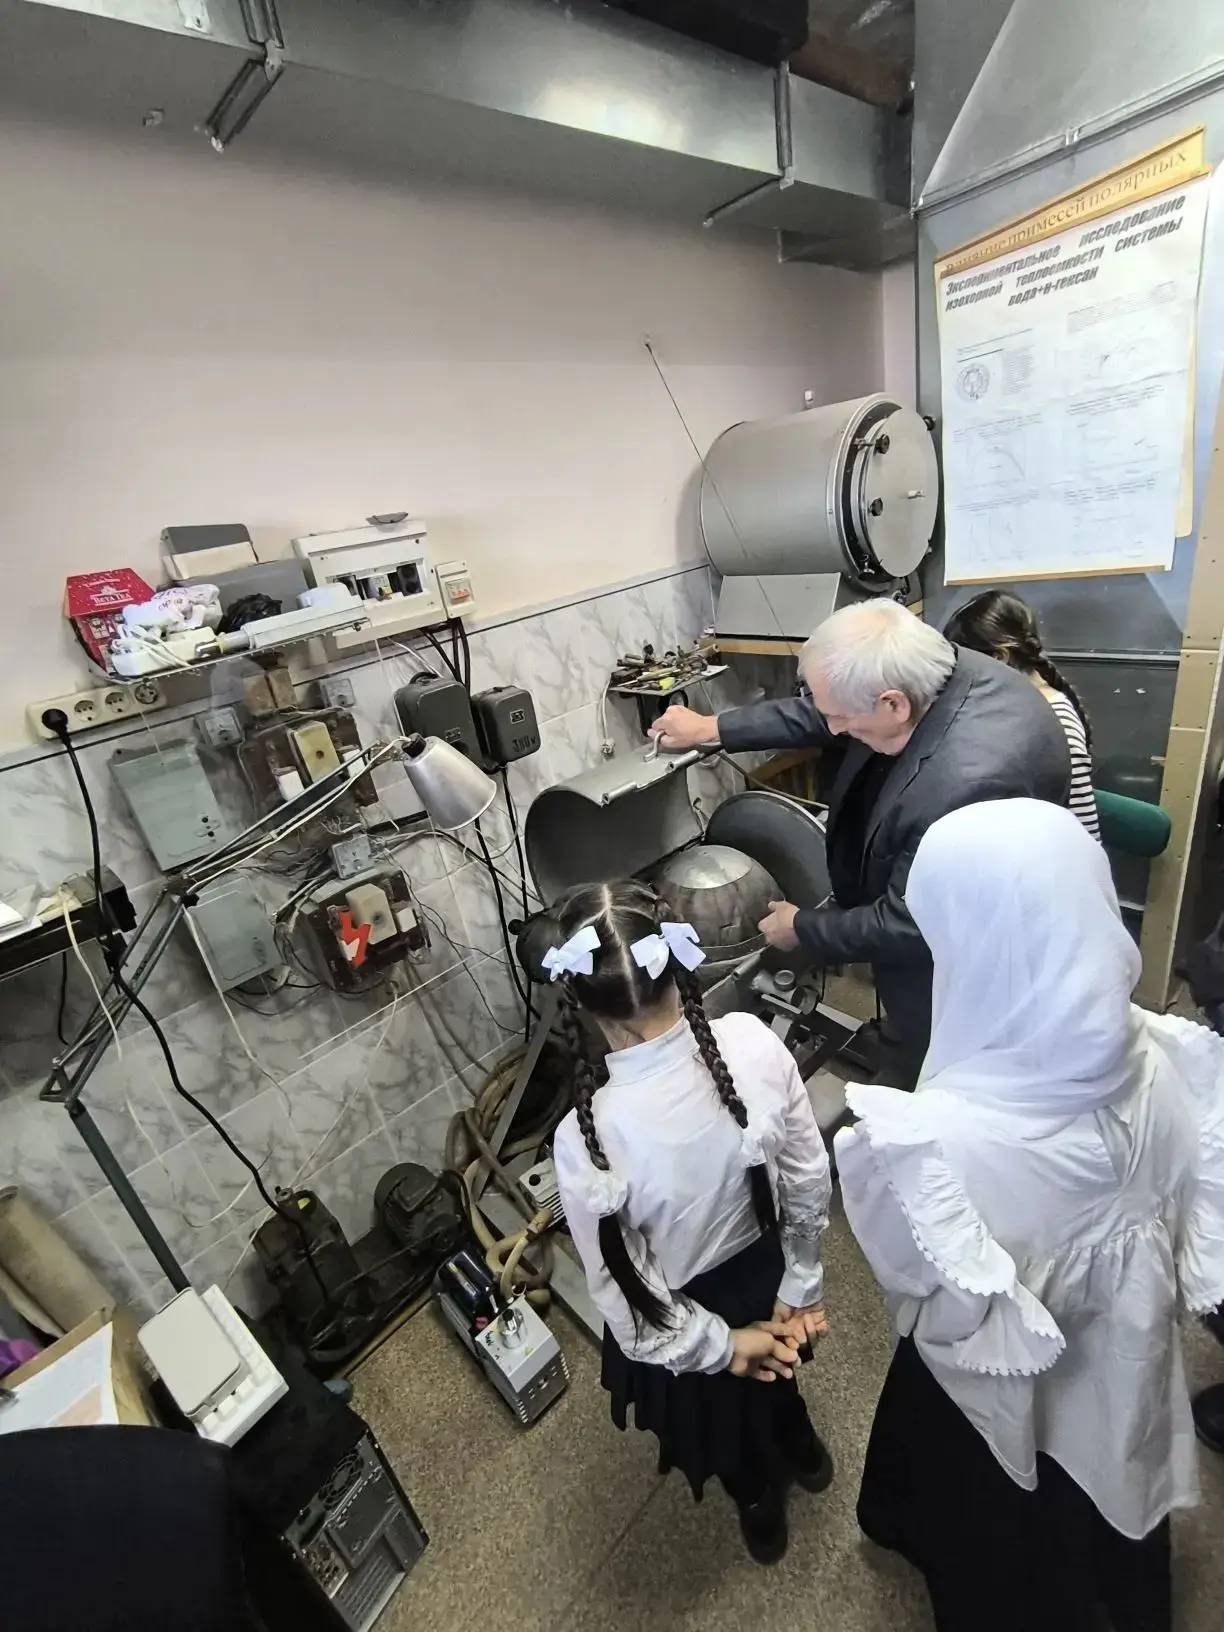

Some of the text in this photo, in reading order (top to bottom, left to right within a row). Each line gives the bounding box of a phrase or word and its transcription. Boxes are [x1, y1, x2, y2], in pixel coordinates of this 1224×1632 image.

[1089, 151, 1186, 207] полярных
[945, 281, 1003, 312] изохорной
[1115, 216, 1184, 252] системы
[946, 195, 1186, 296] Экспериментальное исследование
